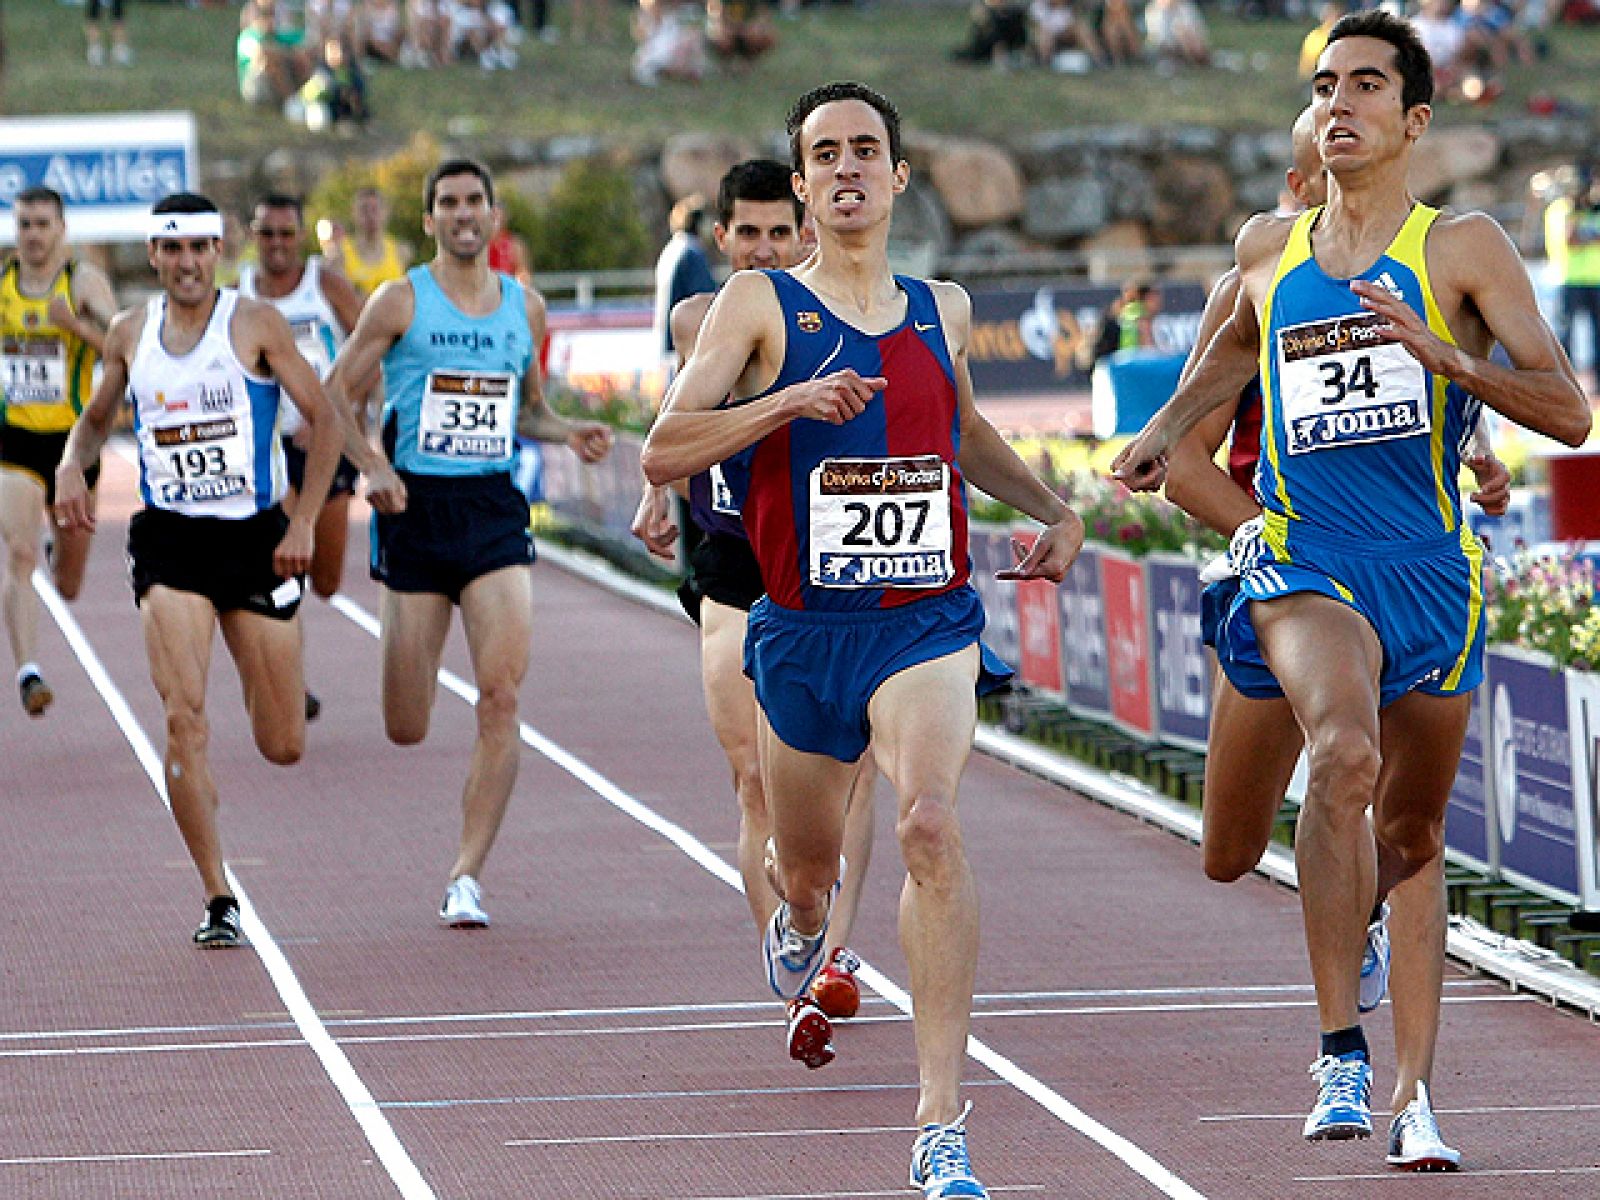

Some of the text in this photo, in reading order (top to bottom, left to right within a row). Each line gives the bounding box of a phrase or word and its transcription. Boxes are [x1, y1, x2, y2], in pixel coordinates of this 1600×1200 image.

[430, 329, 494, 352] nerja
[1319, 355, 1380, 405] 34
[440, 400, 498, 431] 334
[169, 446, 227, 478] 193
[842, 499, 931, 546] 207
